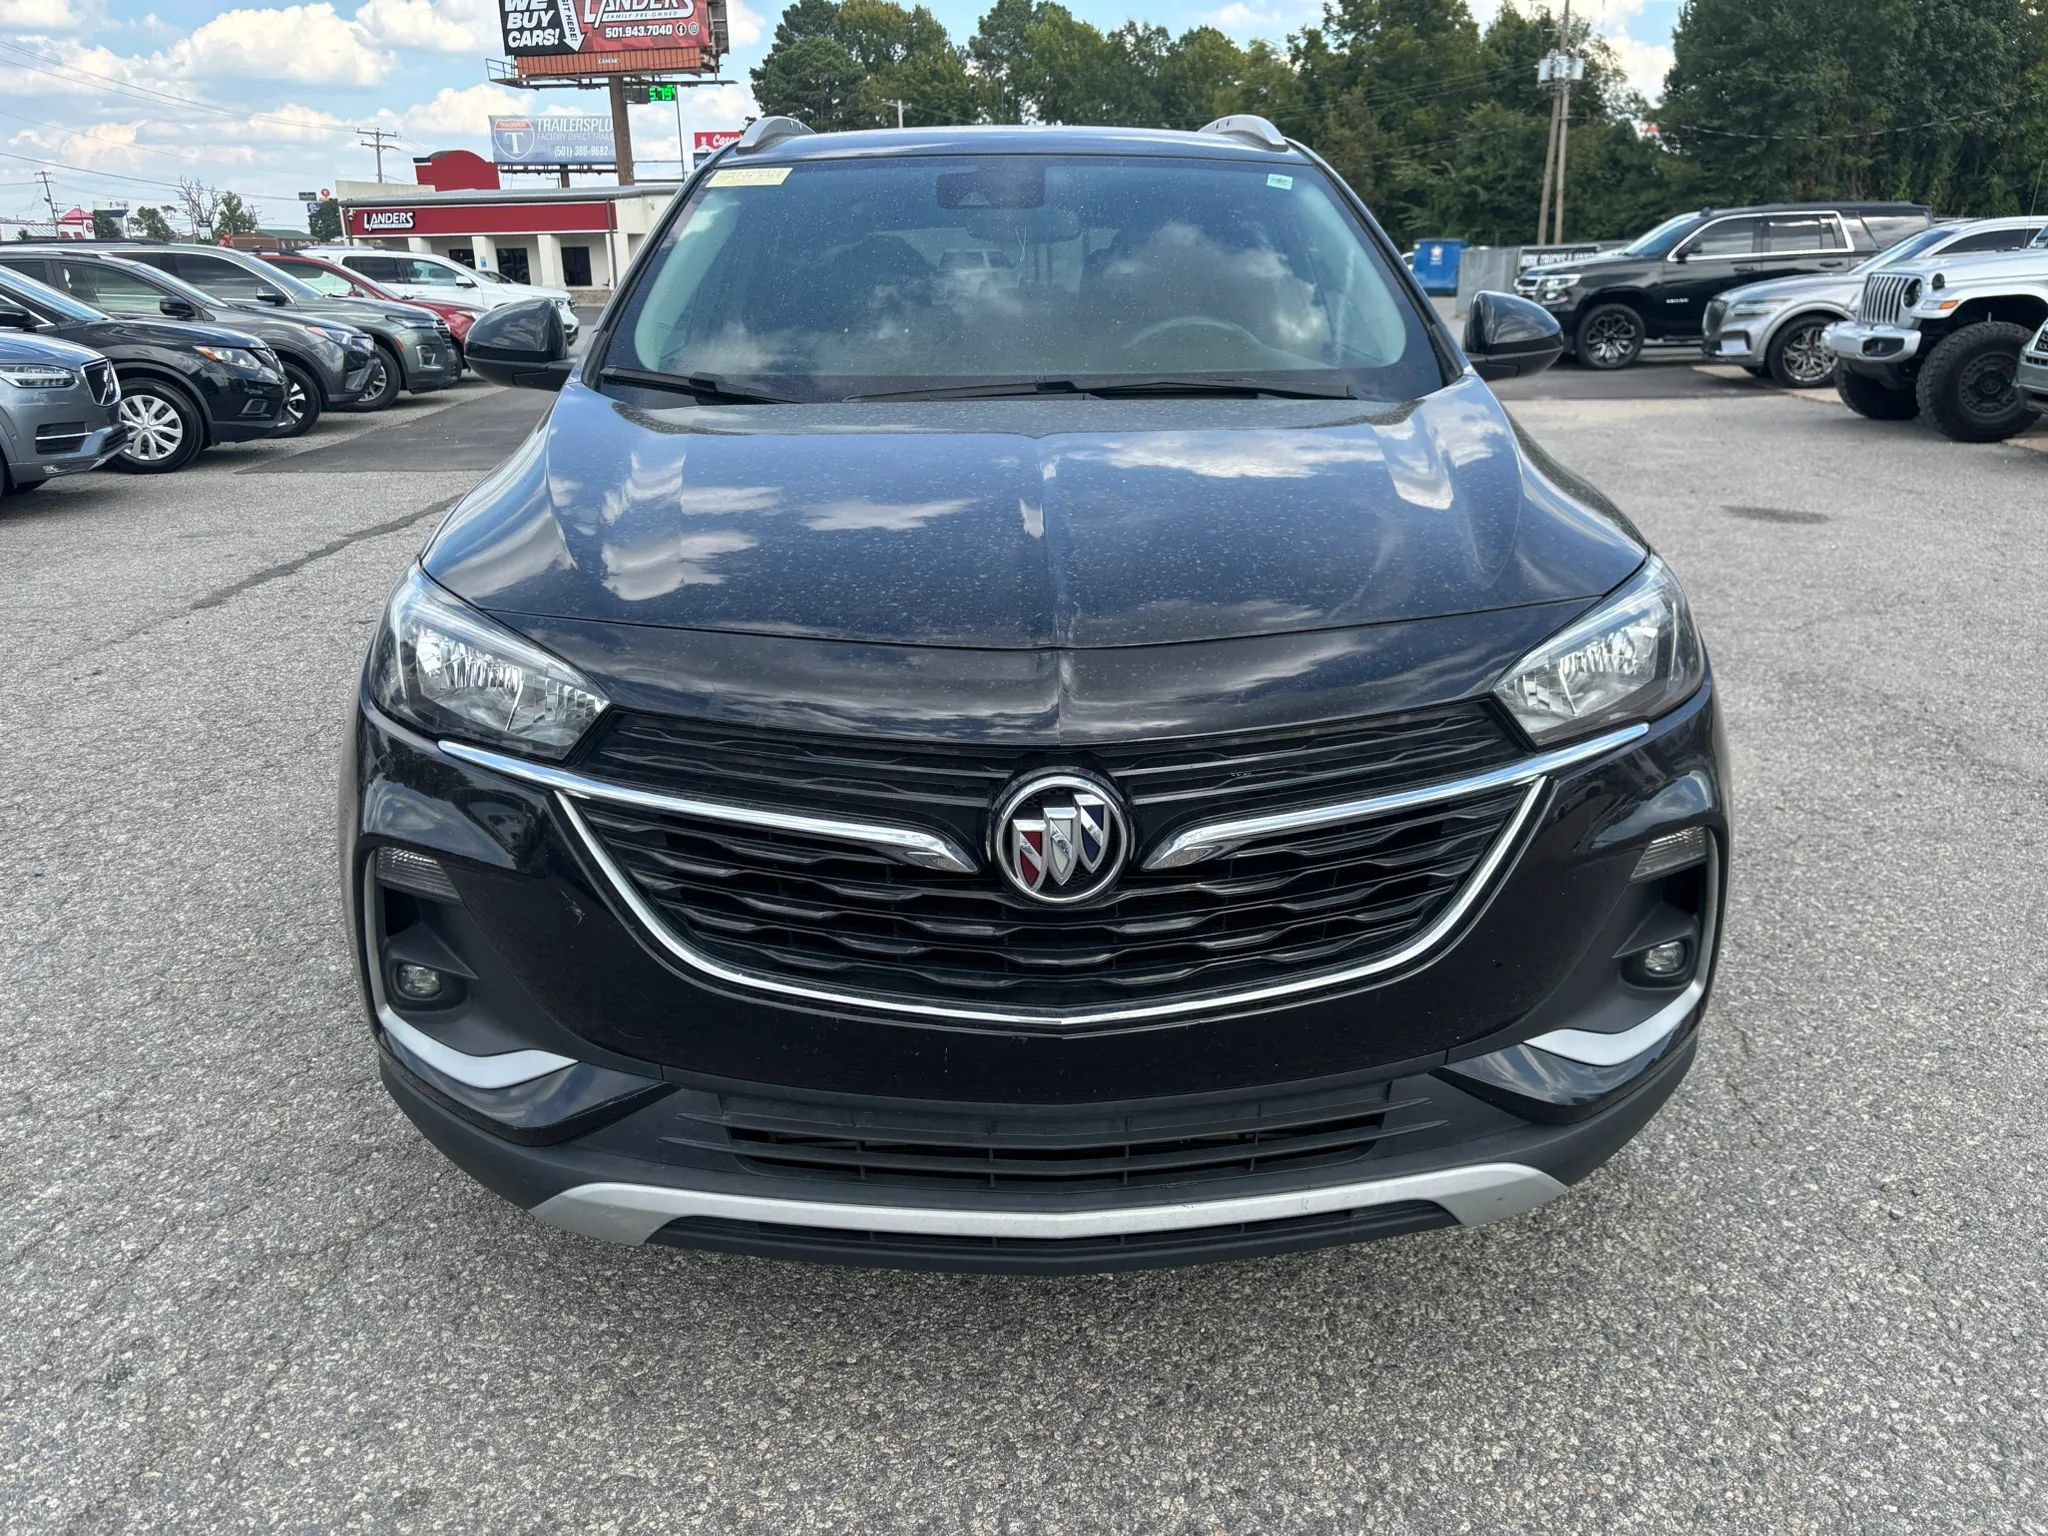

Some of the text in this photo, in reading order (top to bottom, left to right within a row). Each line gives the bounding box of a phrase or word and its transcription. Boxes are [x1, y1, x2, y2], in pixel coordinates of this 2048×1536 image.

[504, 0, 547, 11] WE
[506, 10, 555, 29] BUY
[565, 14, 579, 42] HERE!
[507, 28, 560, 48] CARS!
[605, 24, 673, 38] 501.943.7040
[536, 118, 614, 132] TRAILERSPLU
[504, 132, 524, 154] T
[537, 132, 567, 141] FACTORY
[568, 132, 591, 141] DIRECT
[363, 212, 414, 232] LANDERS
